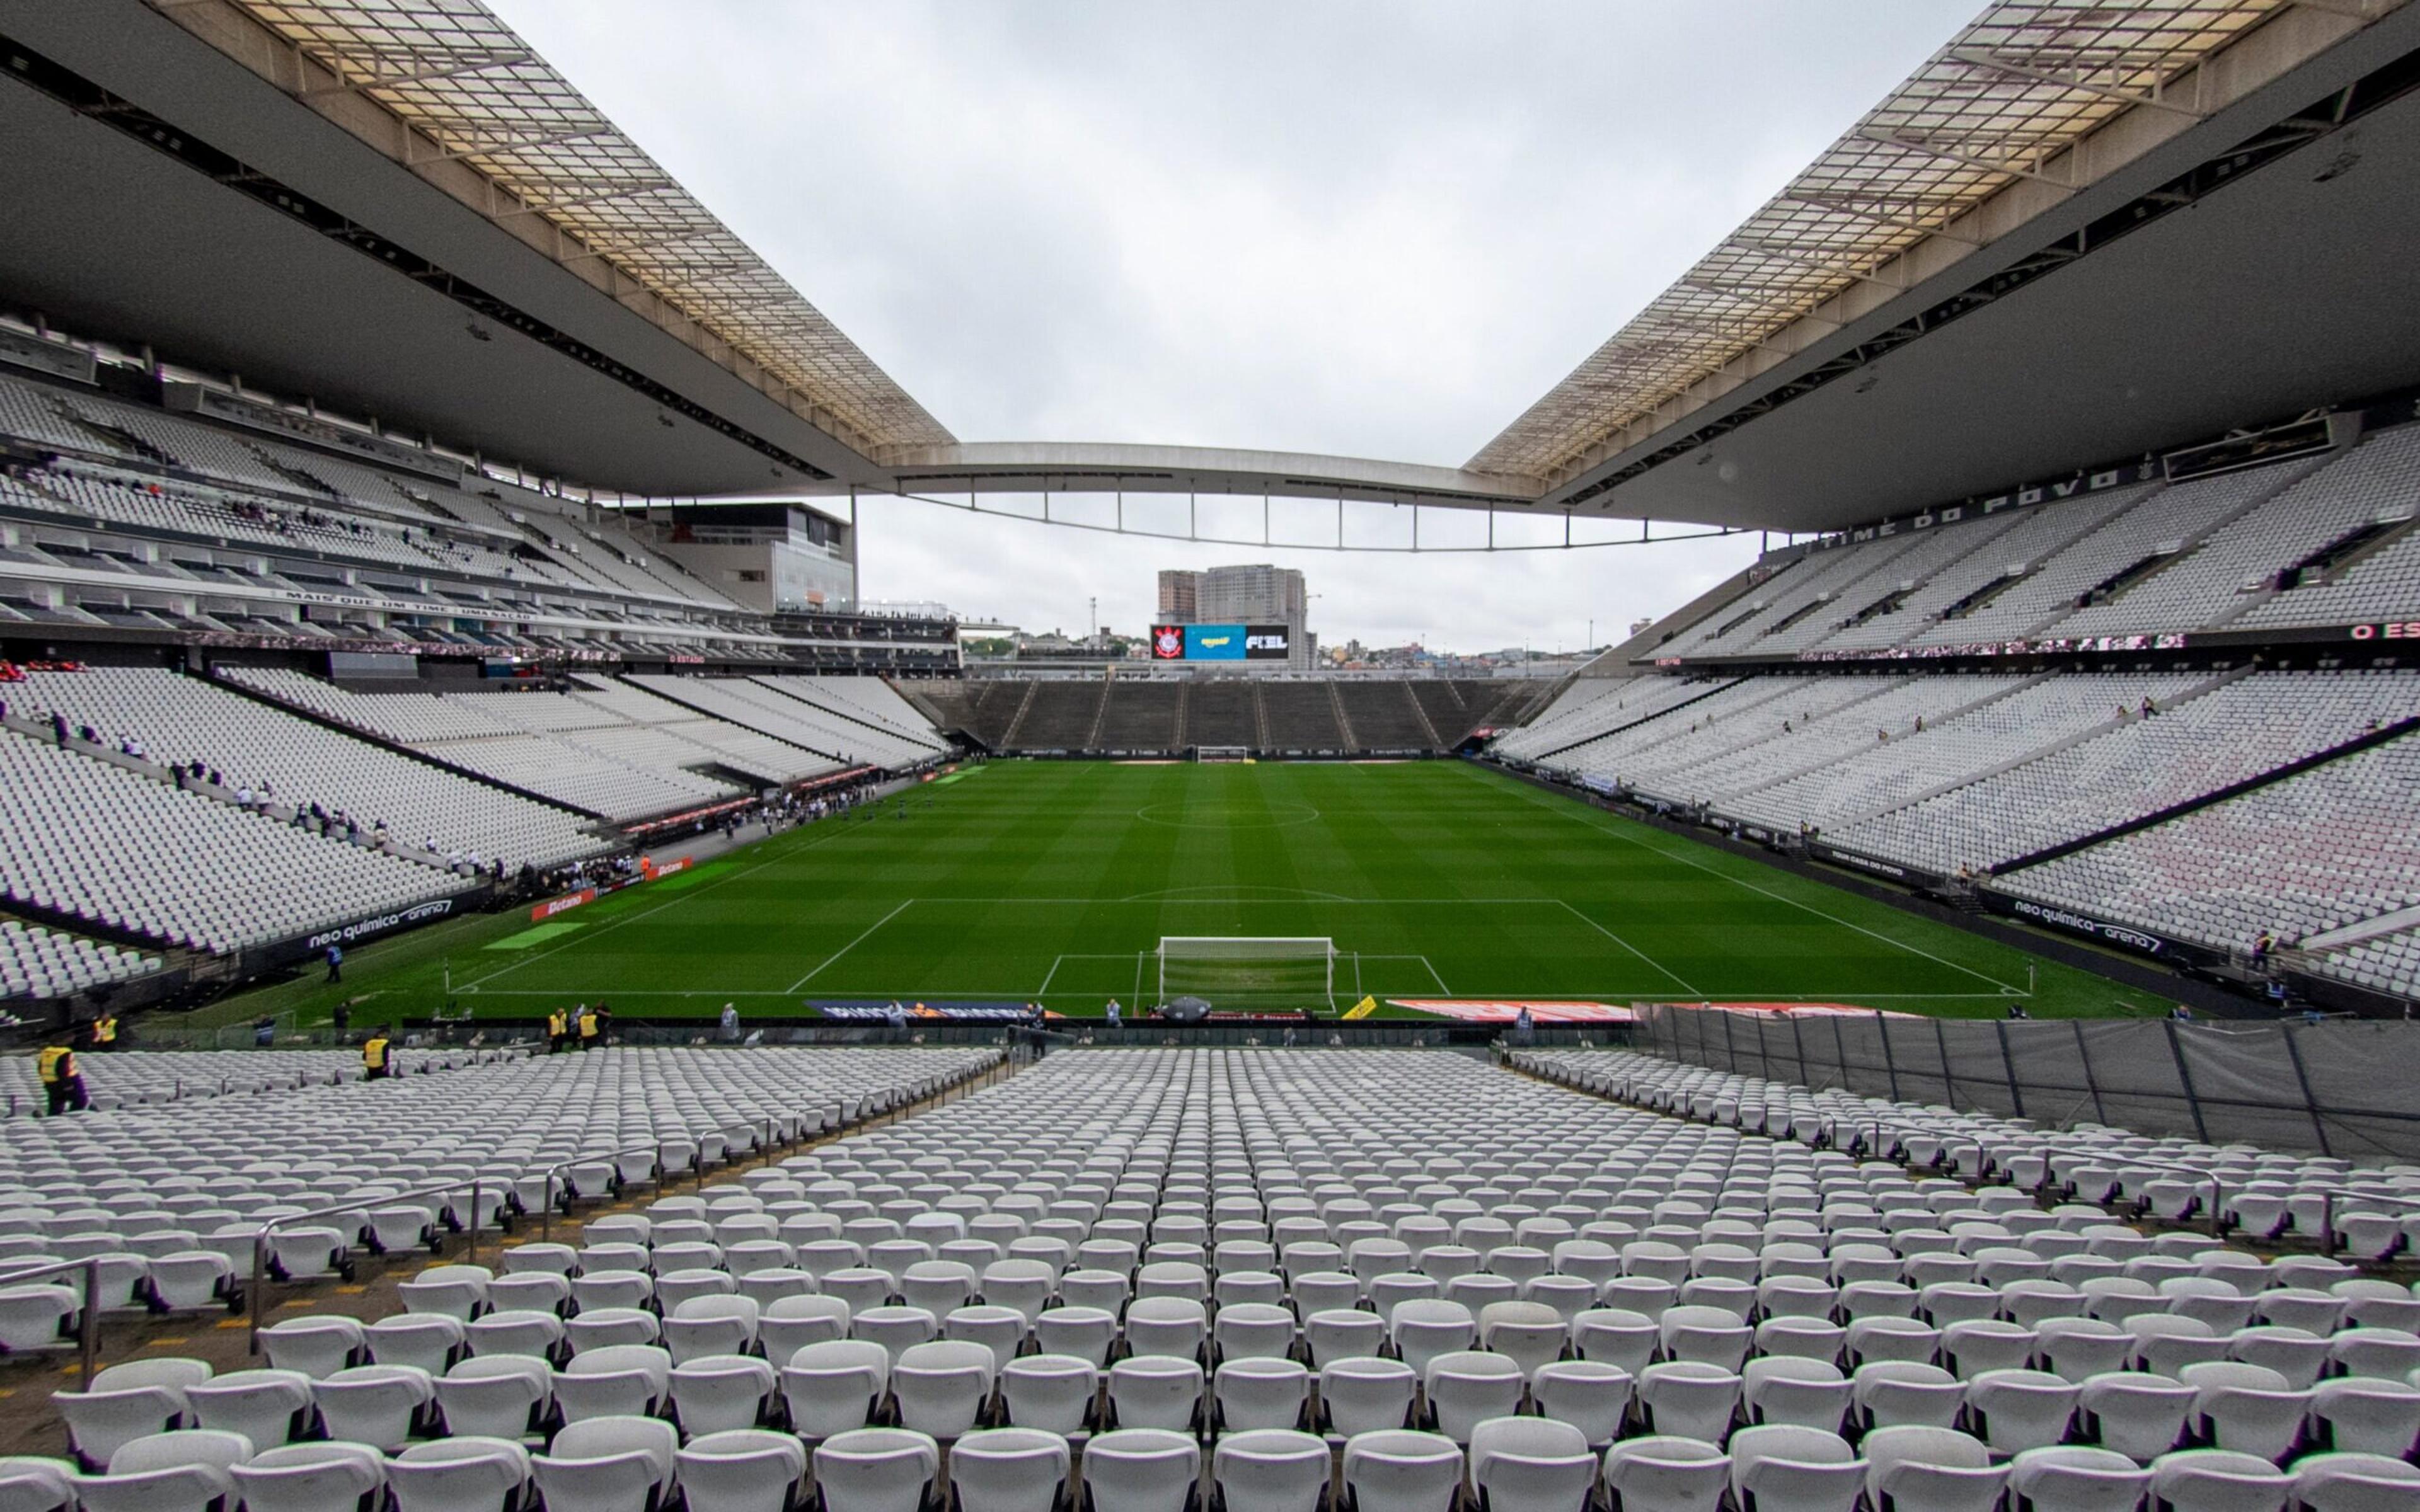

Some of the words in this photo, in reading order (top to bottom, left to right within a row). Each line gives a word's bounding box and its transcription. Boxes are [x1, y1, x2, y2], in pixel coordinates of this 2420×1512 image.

[1820, 522, 1896, 549] TIME
[1914, 507, 1961, 529] DO
[1984, 470, 2118, 513] POVO
[285, 592, 333, 602] MAIS
[340, 597, 375, 605] QUE
[414, 604, 449, 612] TIME
[461, 608, 489, 617] UMA
[2351, 624, 2375, 640] O
[1245, 634, 1288, 650] FIEL
[1869, 861, 1881, 870] DO
[1882, 864, 1903, 876] POVO
[309, 930, 342, 948] neo
[343, 914, 399, 940] química
[408, 903, 443, 920] arena
[2015, 901, 2041, 916] neo
[2041, 907, 2095, 932] química
[2104, 927, 2148, 948] arena
